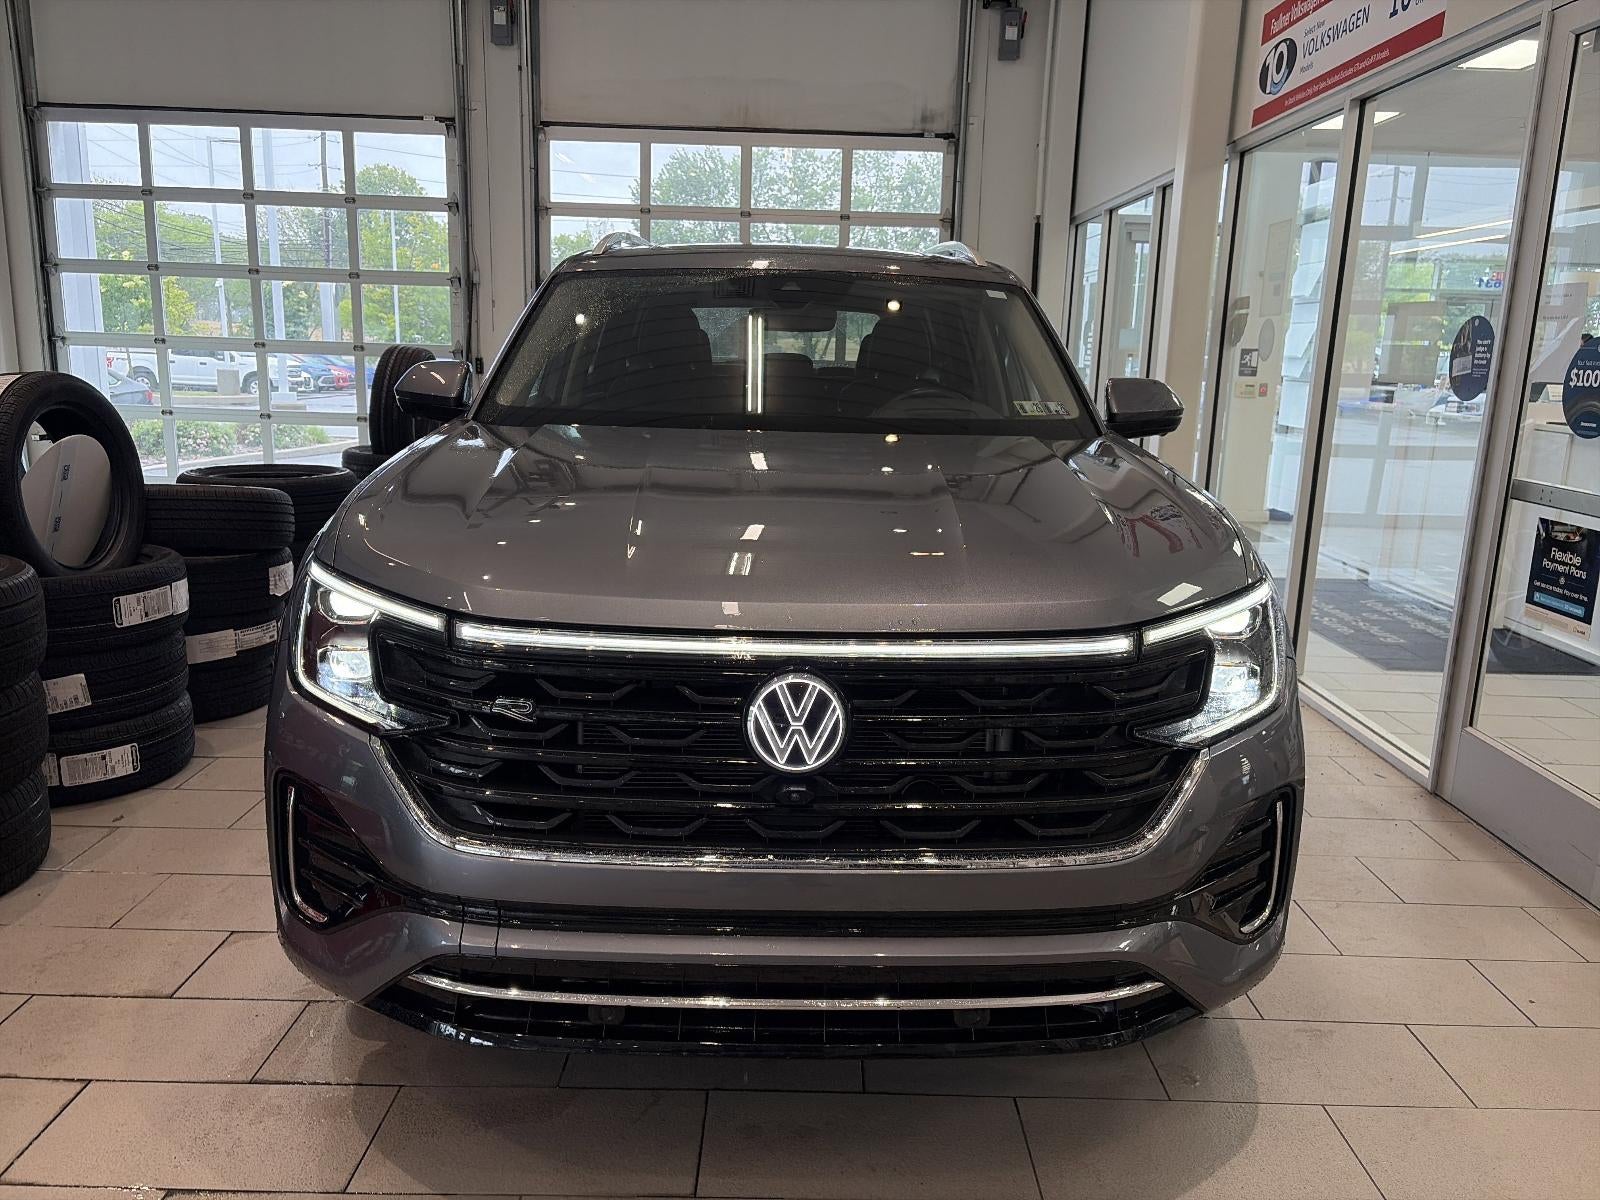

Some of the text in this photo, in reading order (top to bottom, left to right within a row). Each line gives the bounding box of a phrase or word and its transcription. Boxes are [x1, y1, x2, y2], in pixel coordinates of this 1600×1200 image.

[1302, 4, 1371, 60] VOLKSWAGEN
[1569, 367, 1600, 388] $100
[1550, 546, 1582, 567] Flexible
[1542, 558, 1587, 580] Payment Plans
[1533, 579, 1541, 587] Get
[491, 696, 534, 722] R
[752, 680, 842, 768] VW
